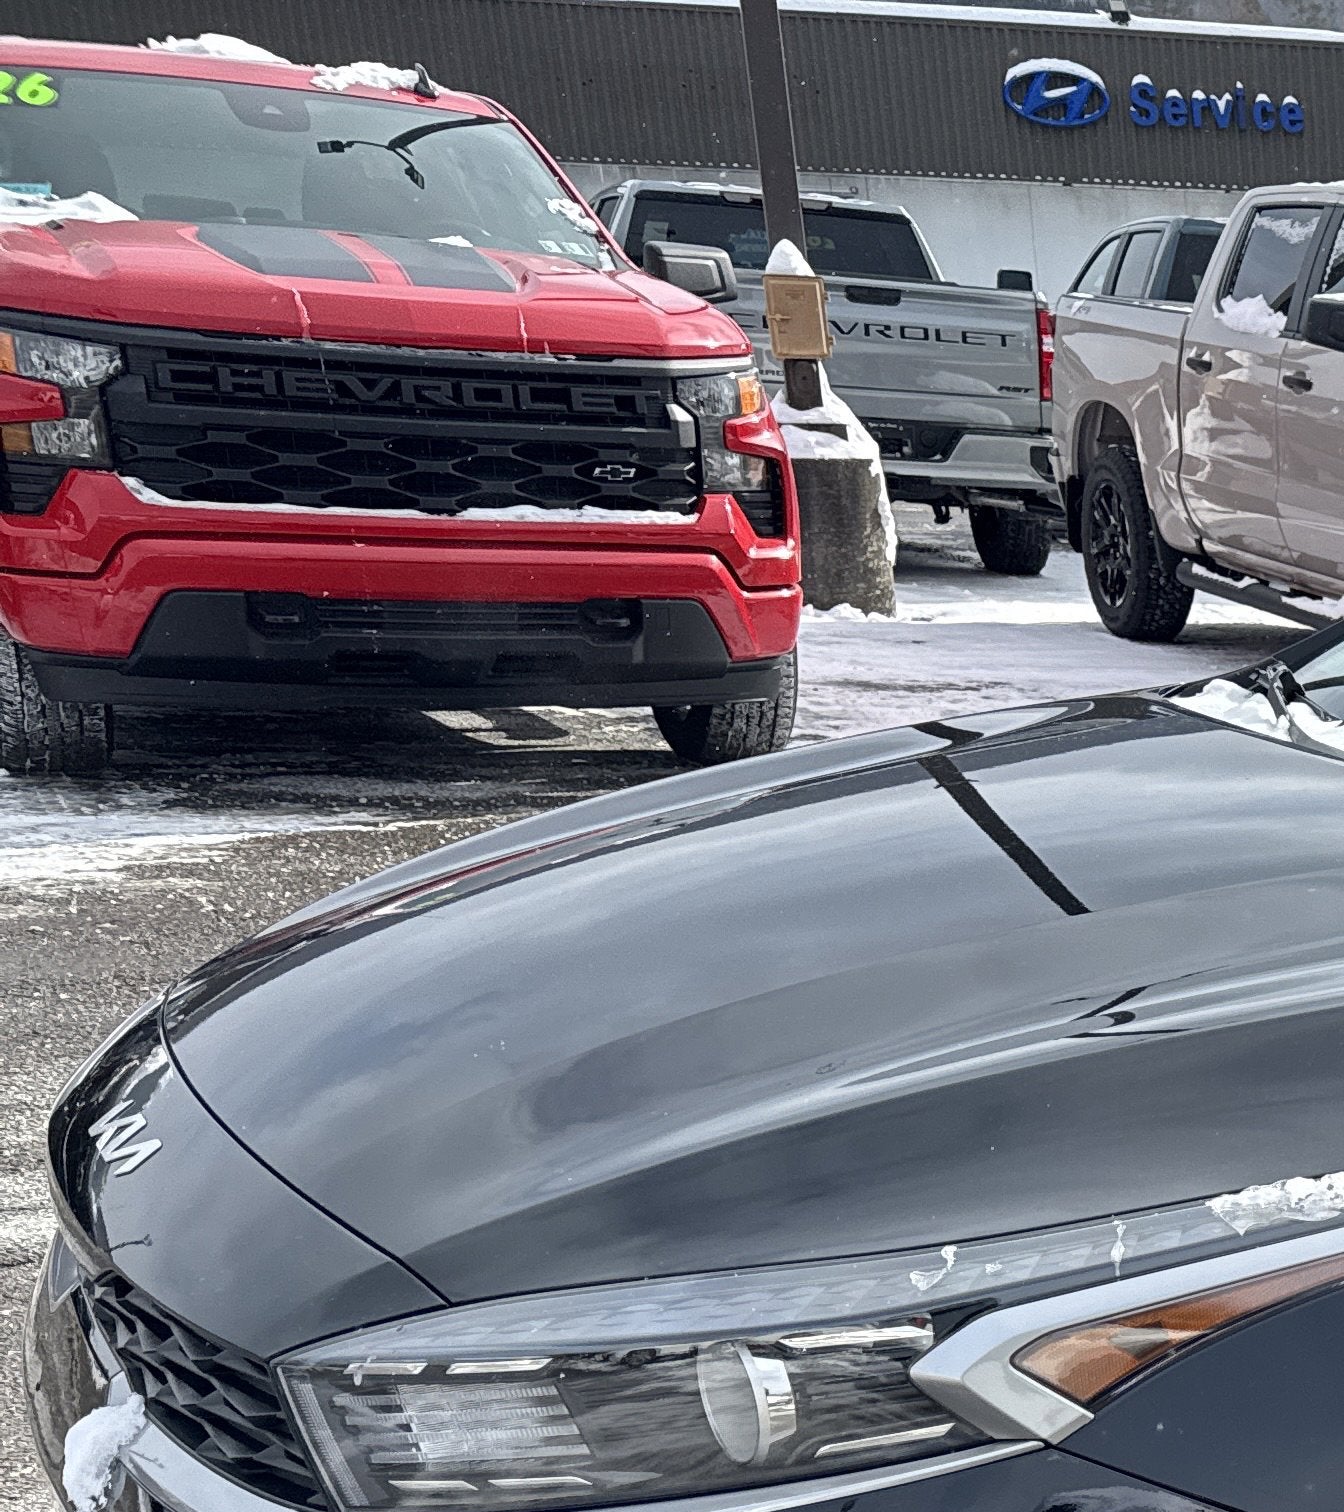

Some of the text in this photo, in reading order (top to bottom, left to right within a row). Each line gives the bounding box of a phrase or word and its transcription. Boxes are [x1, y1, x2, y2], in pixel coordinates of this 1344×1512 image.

[1129, 73, 1305, 133] Service
[728, 312, 1017, 348] CVROLET
[153, 361, 662, 415] CHEVROLET
